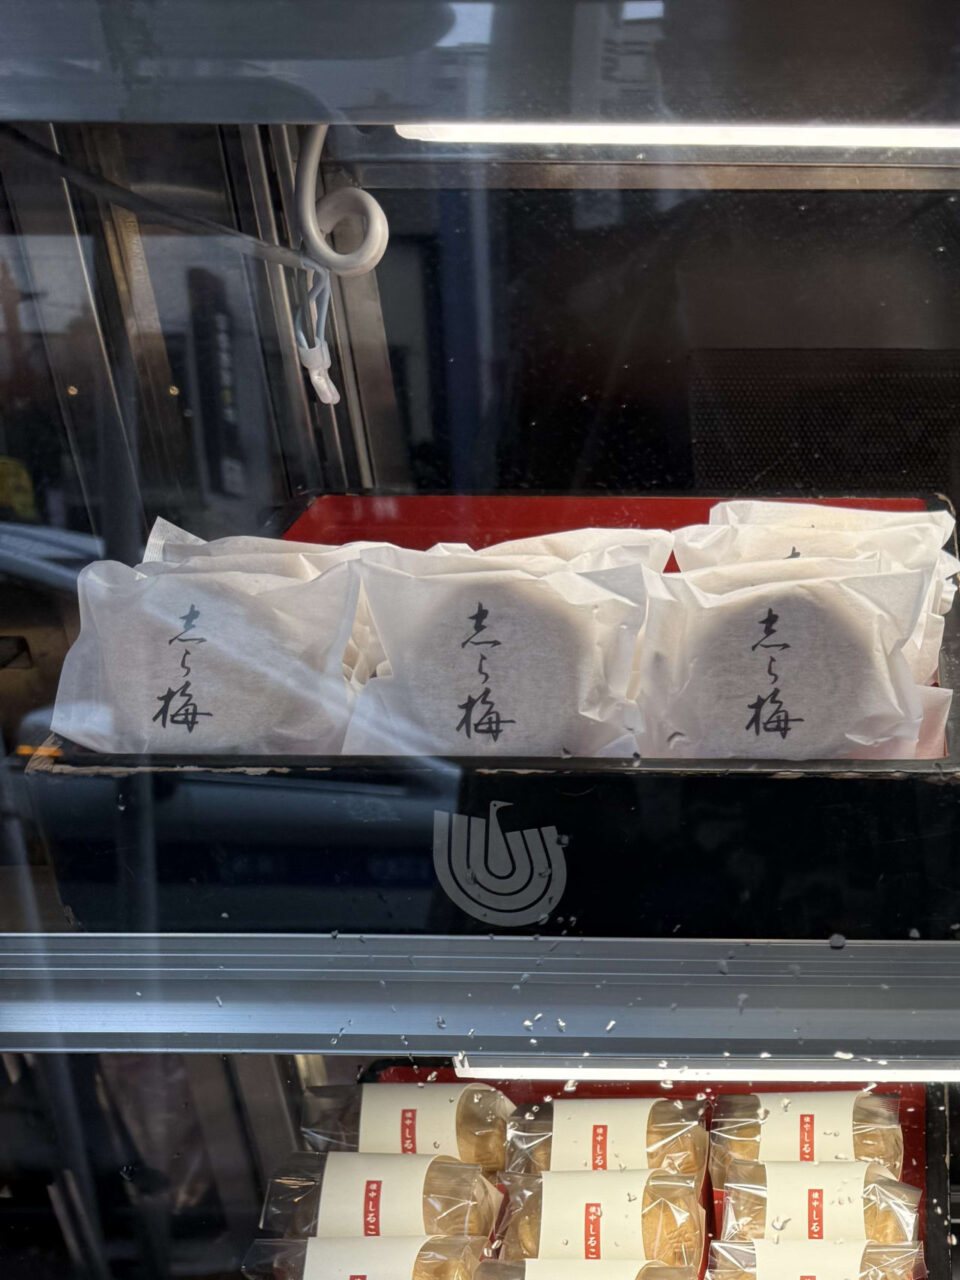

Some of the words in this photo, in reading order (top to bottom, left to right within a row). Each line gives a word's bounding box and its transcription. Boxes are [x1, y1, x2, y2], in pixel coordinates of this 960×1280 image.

[403, 1111, 415, 1154] 懐中しる
[594, 1127, 605, 1170] 懐中しる
